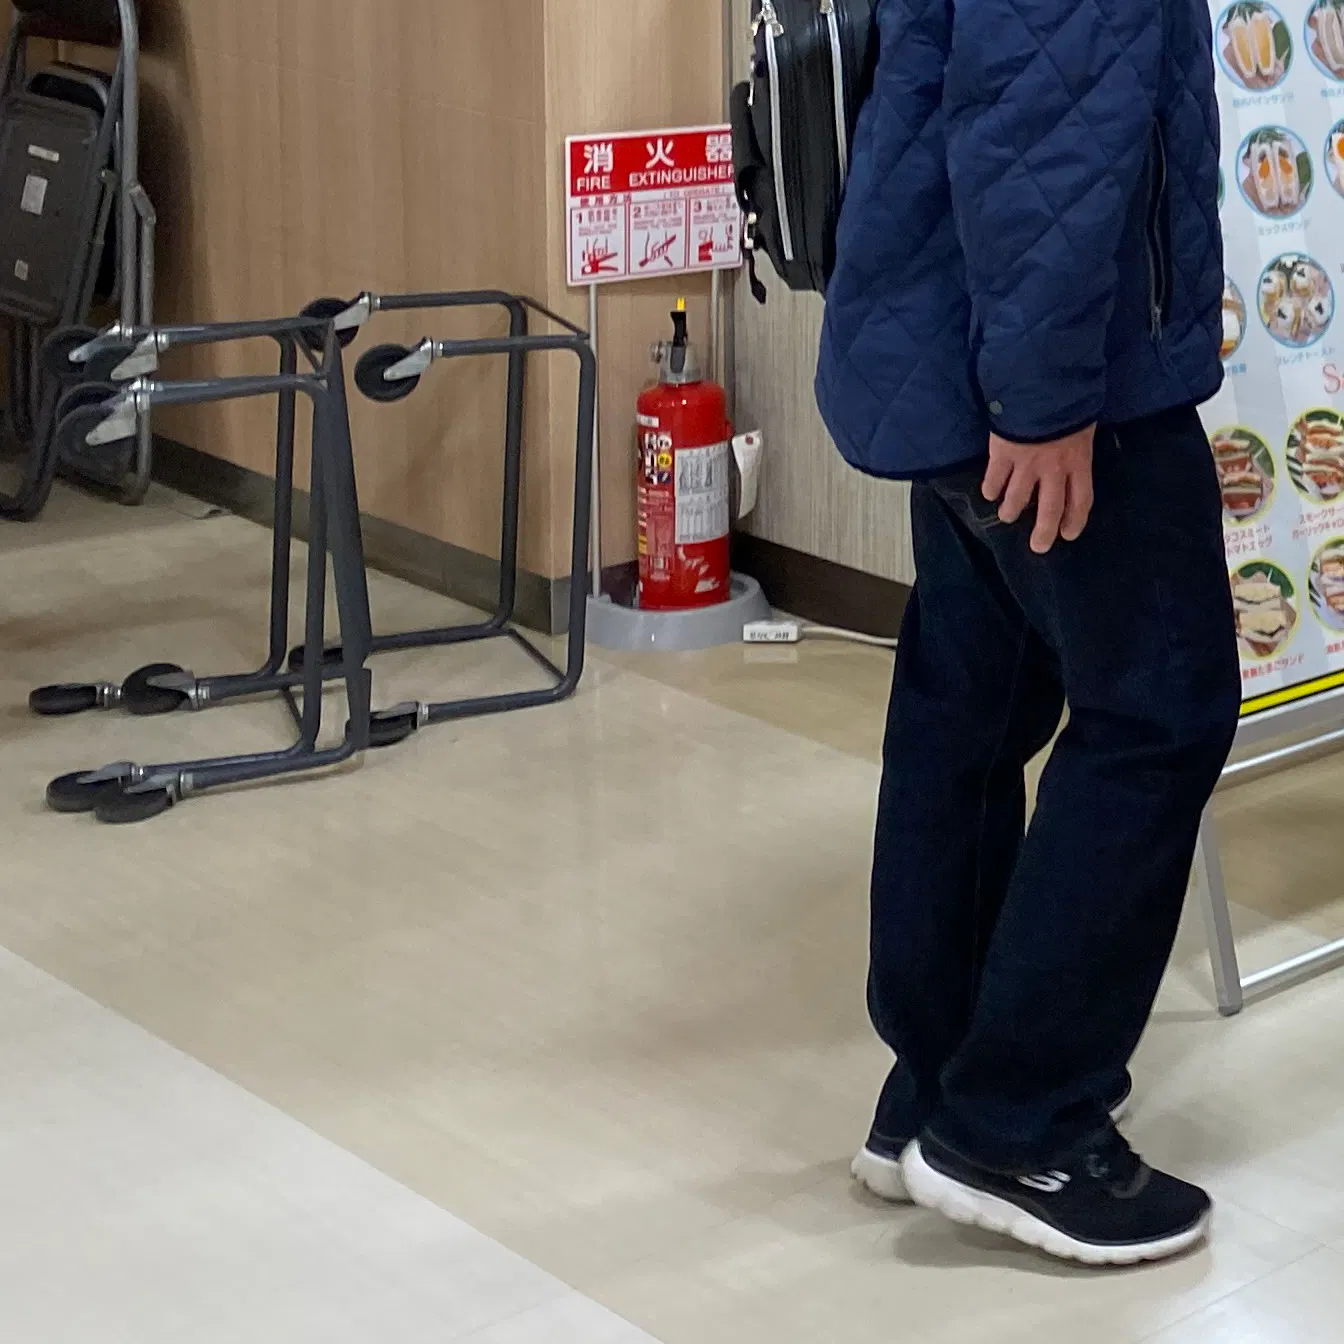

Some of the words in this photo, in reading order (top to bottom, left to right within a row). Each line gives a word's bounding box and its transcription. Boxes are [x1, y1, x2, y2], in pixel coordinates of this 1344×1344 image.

[584, 134, 732, 174] 消火器
[577, 175, 611, 192] FIRE
[633, 207, 642, 219] 2
[694, 202, 702, 213] 3
